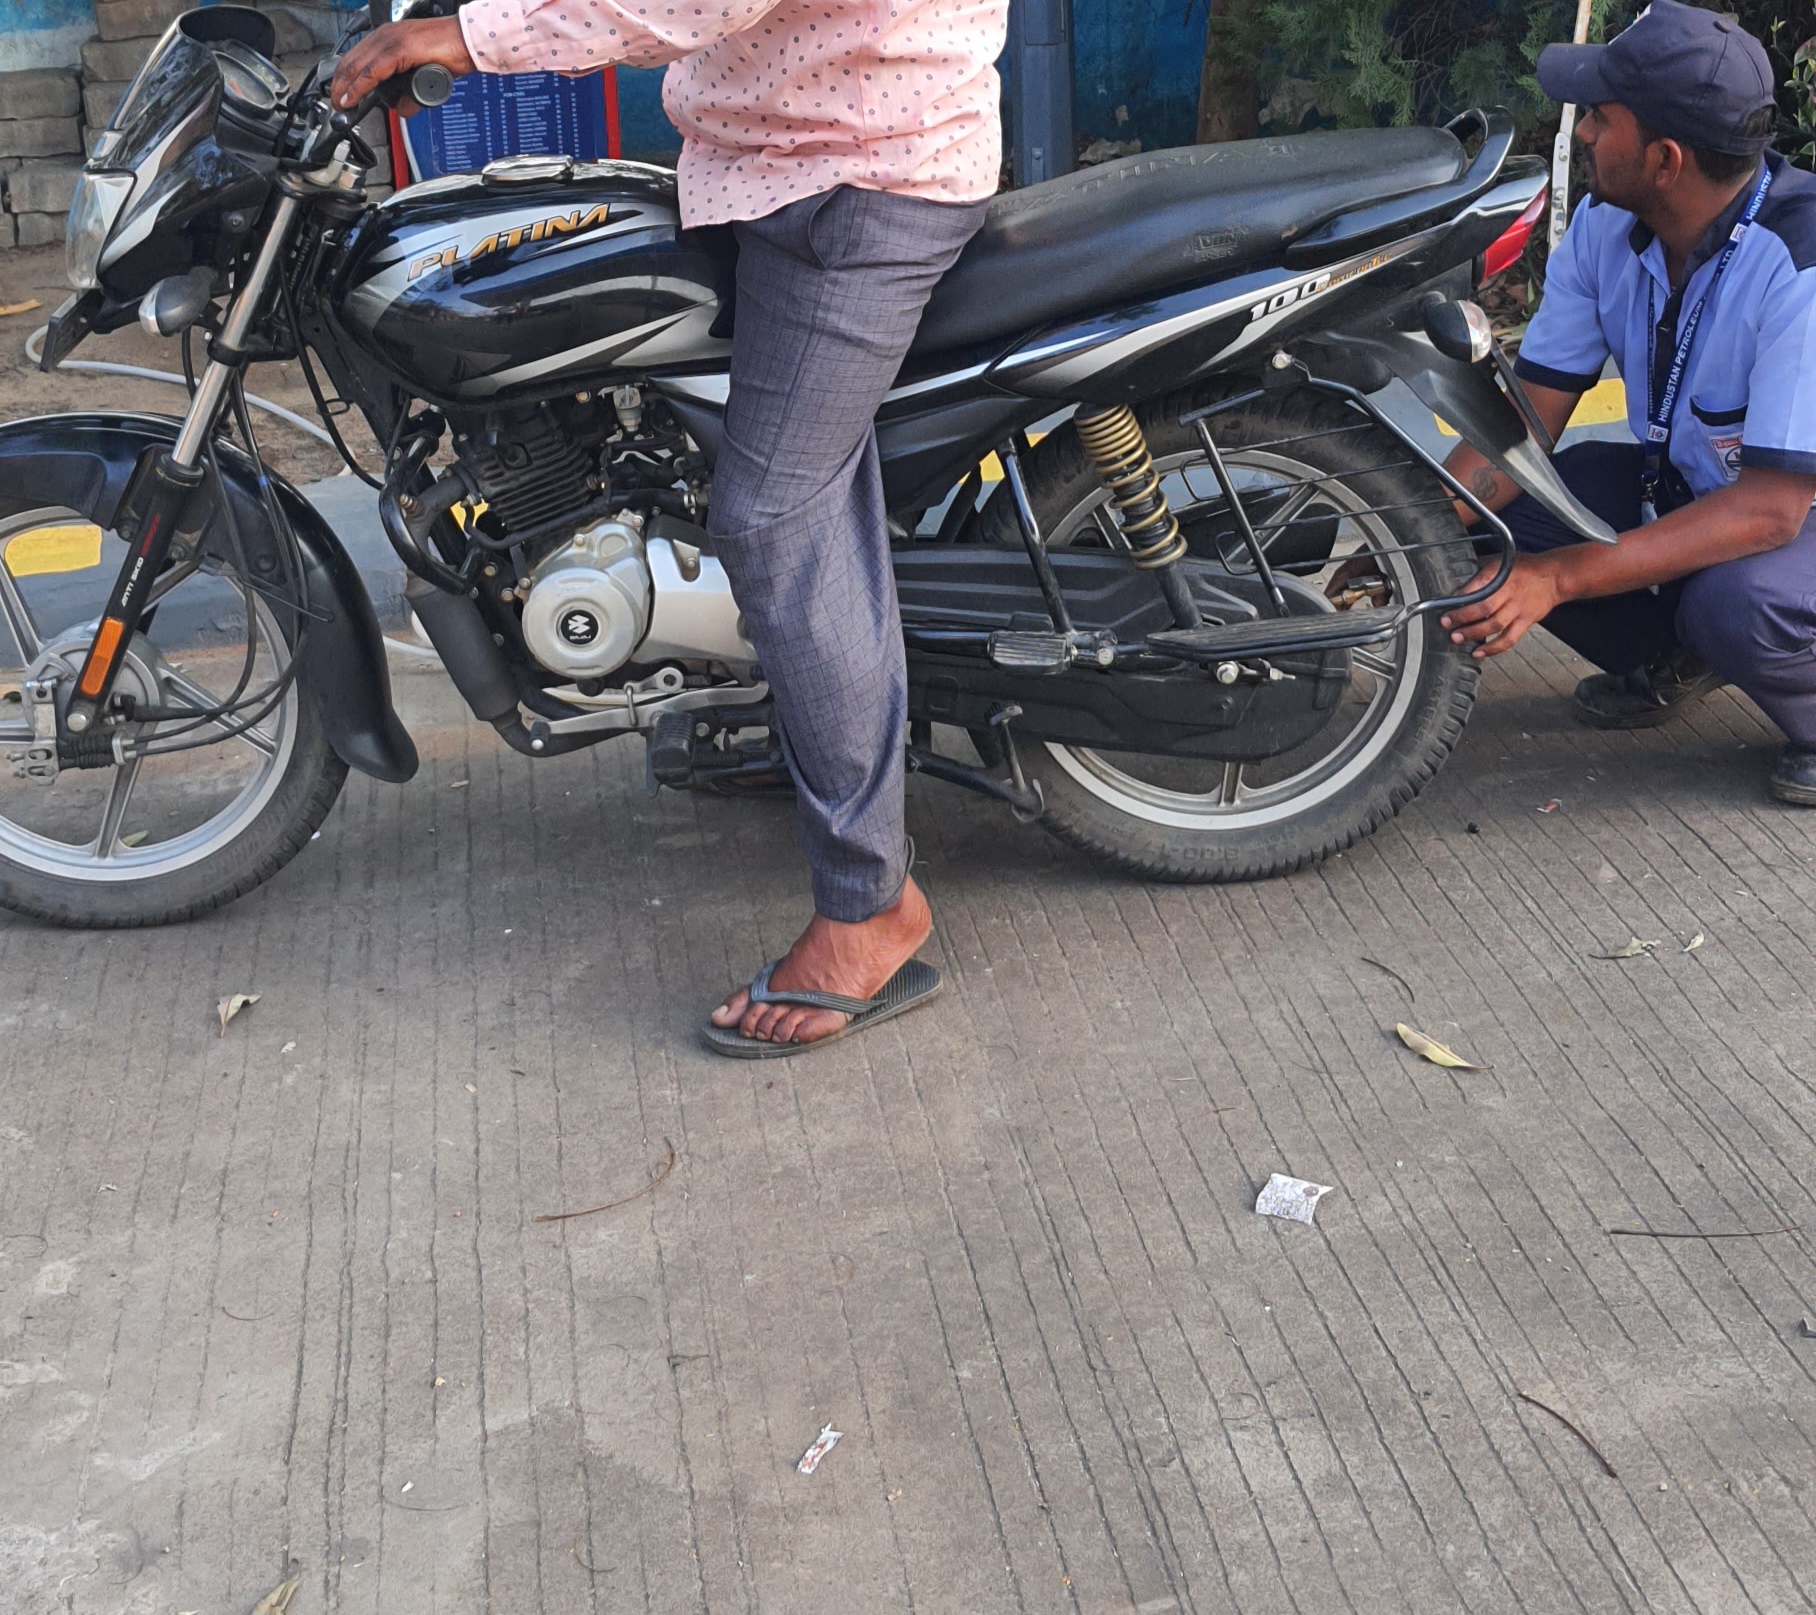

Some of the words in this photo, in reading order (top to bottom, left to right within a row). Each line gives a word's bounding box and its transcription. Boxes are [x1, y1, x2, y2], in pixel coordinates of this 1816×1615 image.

[407, 202, 611, 282] PLATINA
[1251, 272, 1331, 322] 100
[1657, 364, 1682, 423] HINDUSTAN
